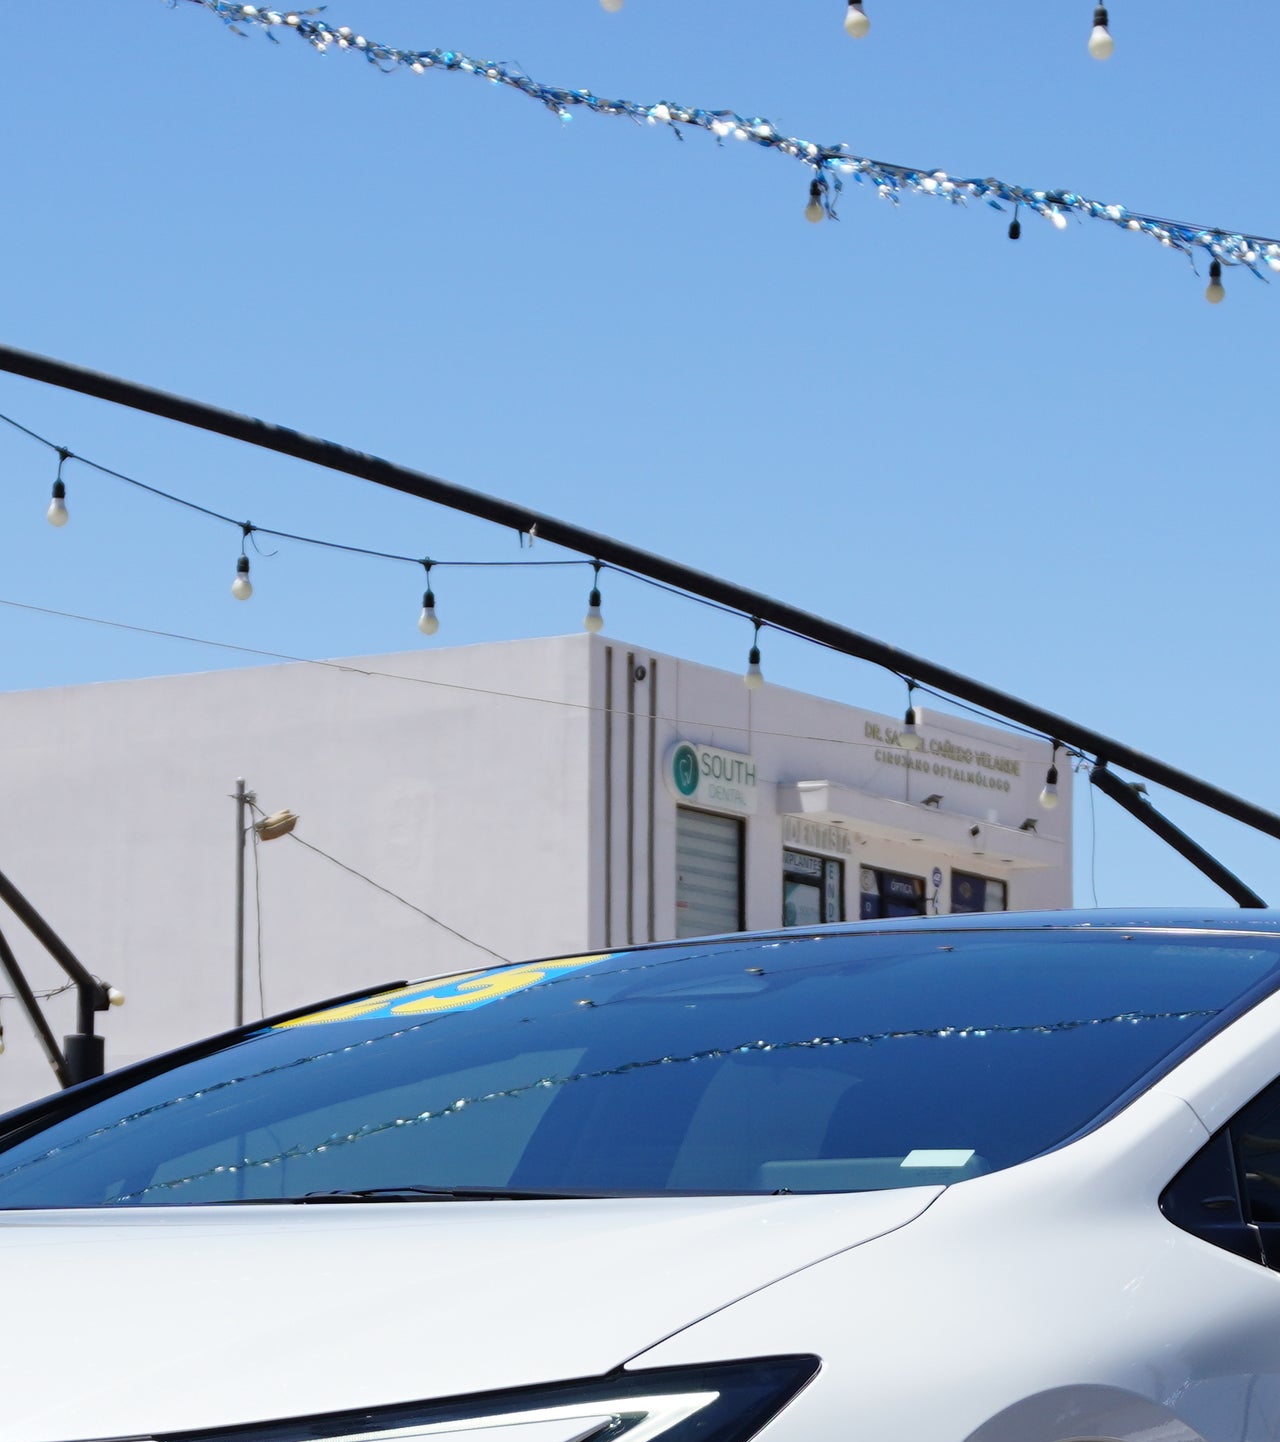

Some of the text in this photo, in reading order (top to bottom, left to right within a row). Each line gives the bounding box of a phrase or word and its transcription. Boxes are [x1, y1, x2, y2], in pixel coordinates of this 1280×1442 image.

[701, 752, 757, 787] SOUTH
[874, 749, 1012, 793] CIRUJANO OFTALMÓLOGO
